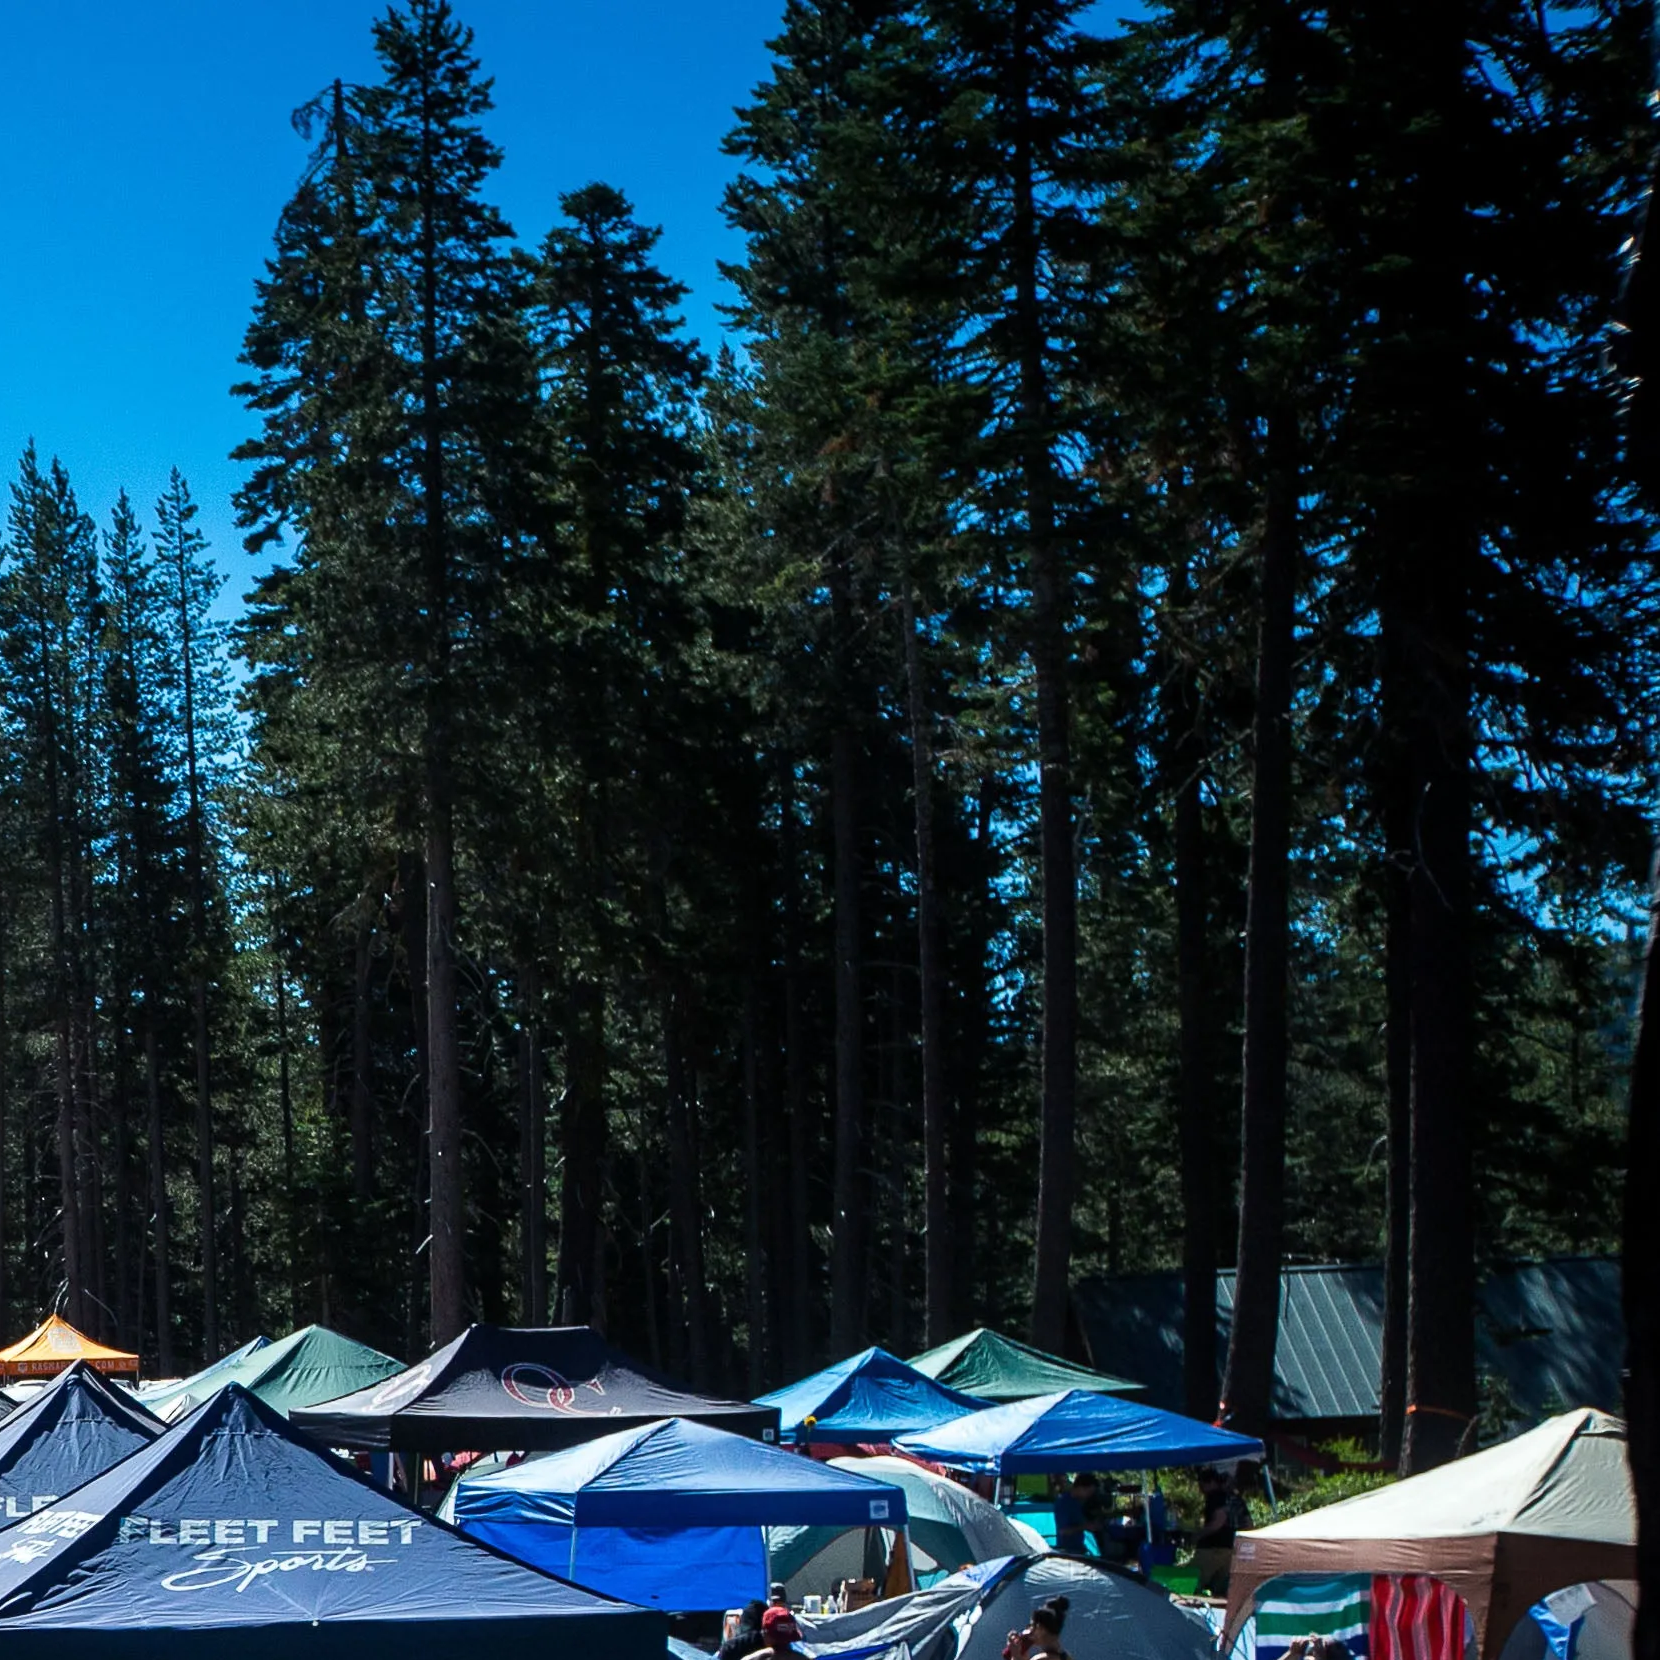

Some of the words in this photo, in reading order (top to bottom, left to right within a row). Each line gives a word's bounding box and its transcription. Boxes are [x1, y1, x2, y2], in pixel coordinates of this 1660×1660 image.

[119, 1517, 279, 1545] FLEET
[293, 1519, 422, 1546] FEET
[160, 1546, 398, 1593] Sports
